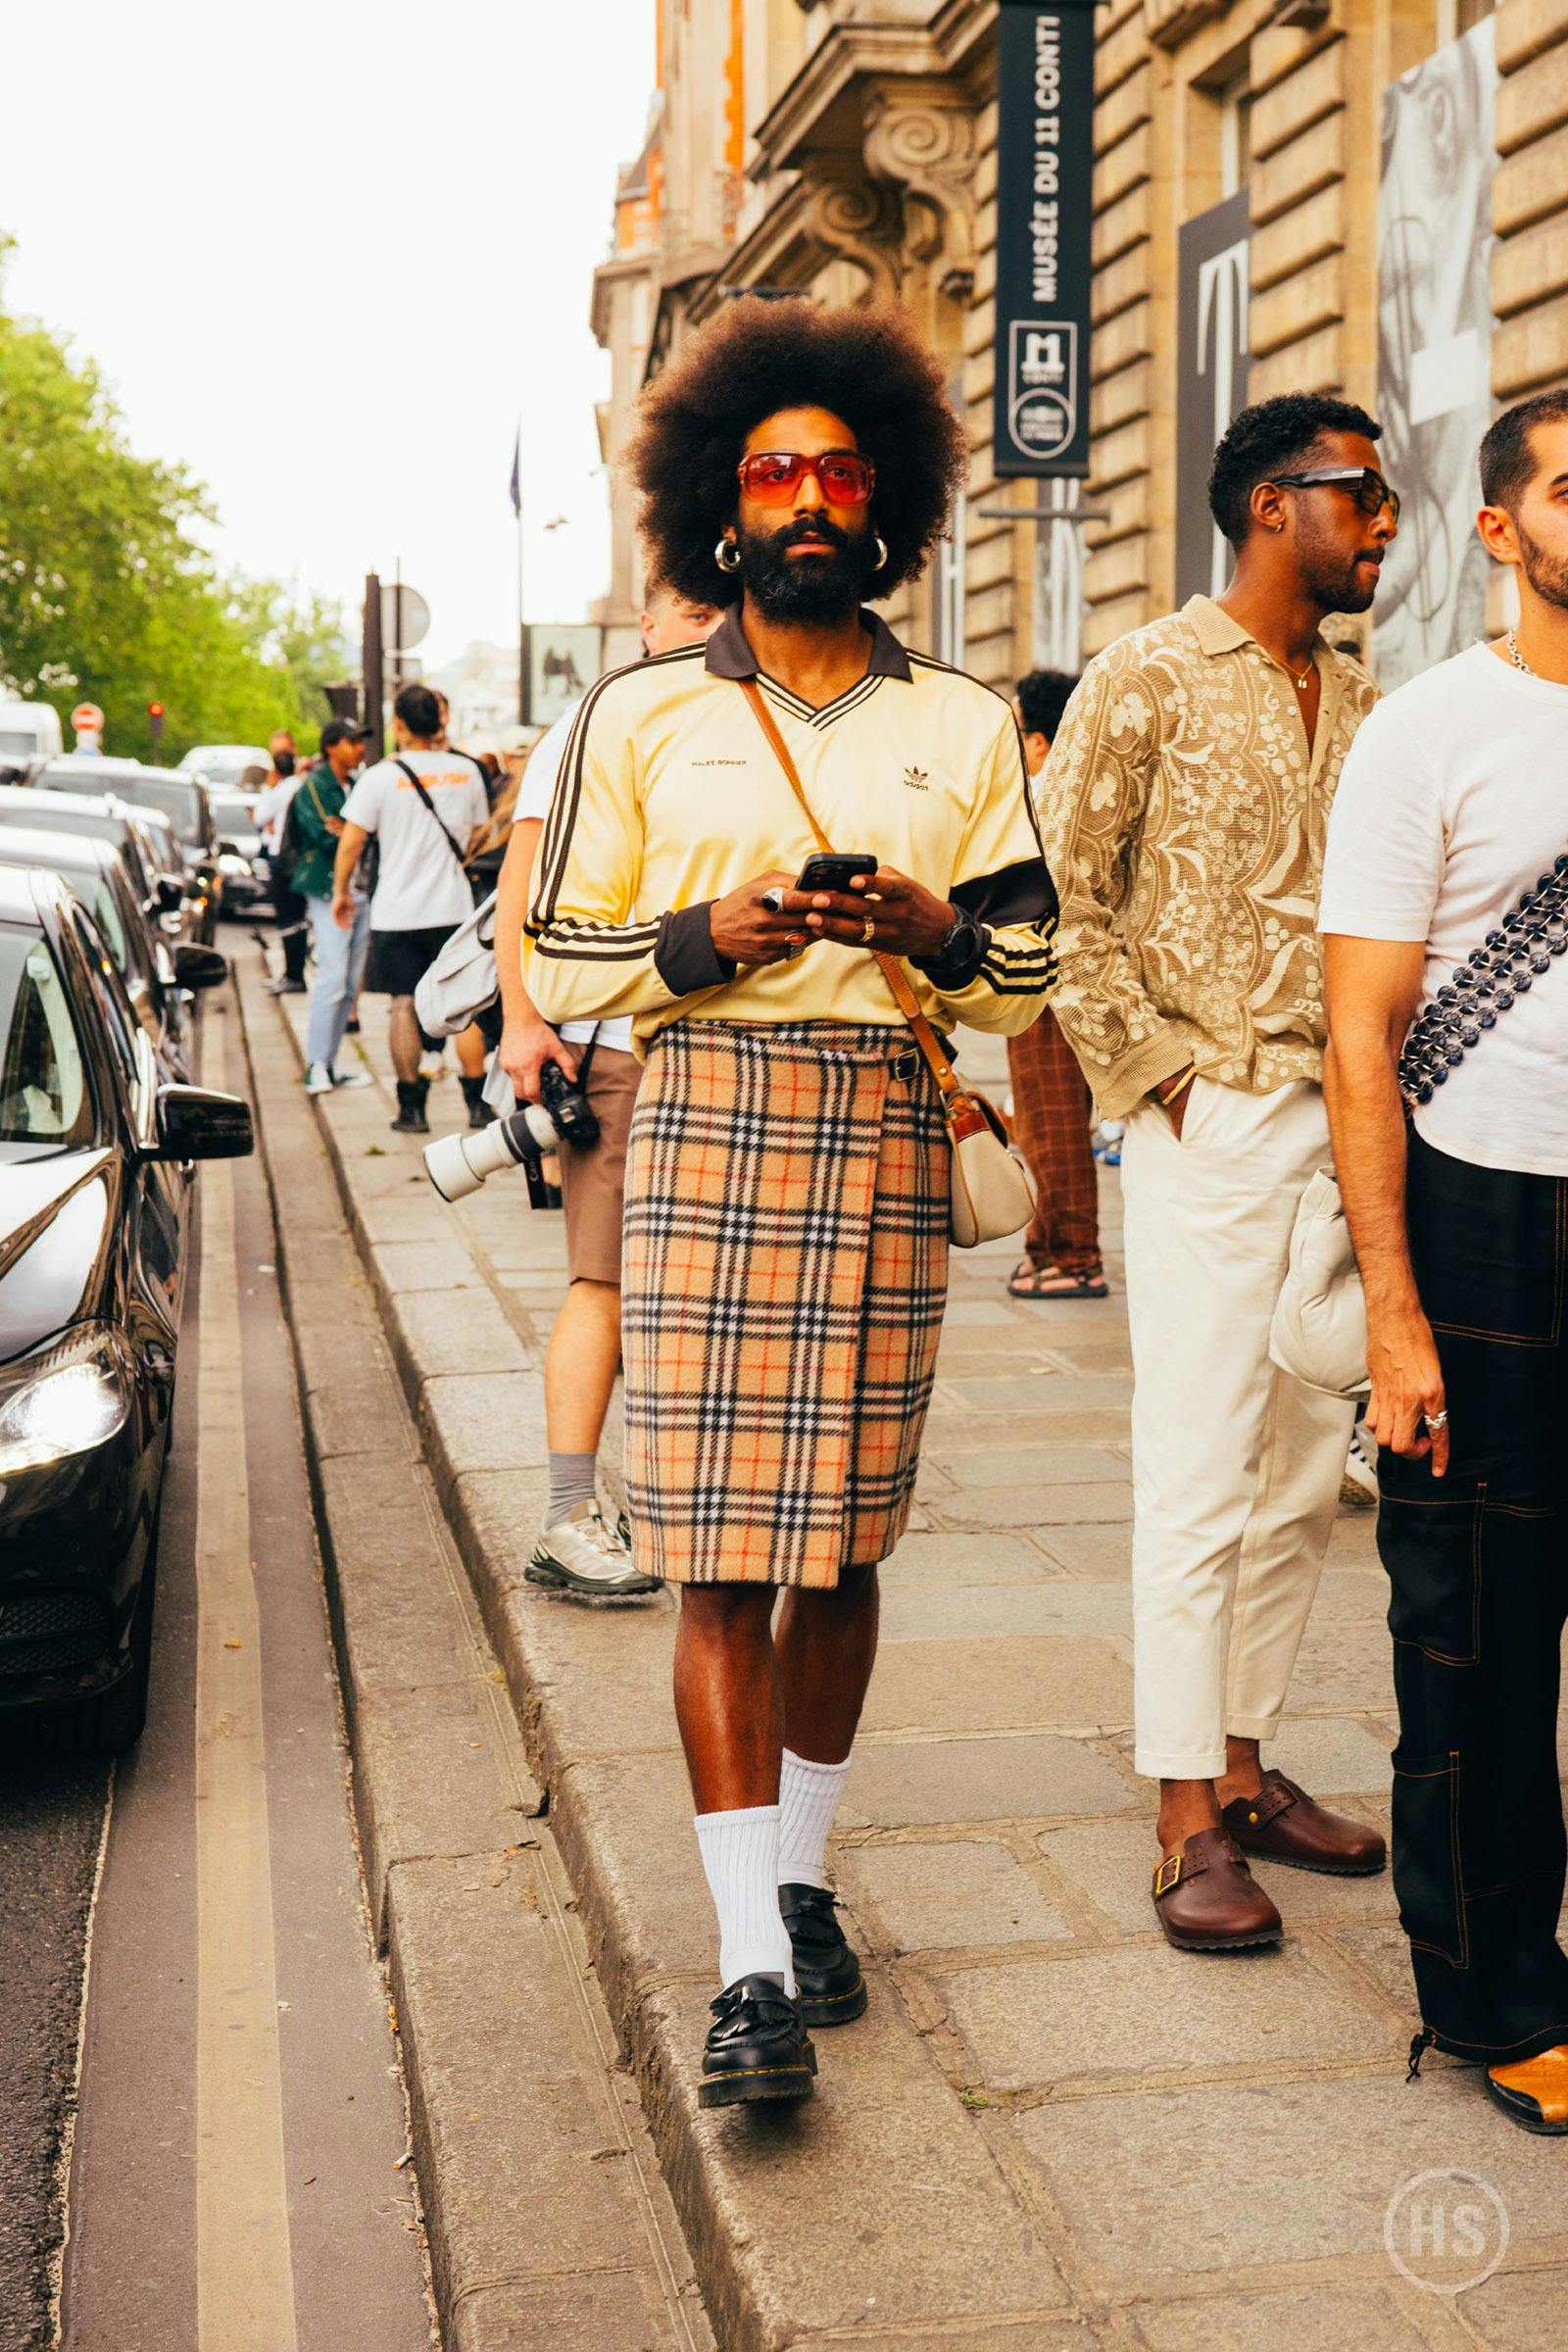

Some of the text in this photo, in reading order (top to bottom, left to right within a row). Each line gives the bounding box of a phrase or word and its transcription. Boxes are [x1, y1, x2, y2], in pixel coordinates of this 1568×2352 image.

[1028, 15, 1060, 302] MUSÉE DU 11 CONTI
